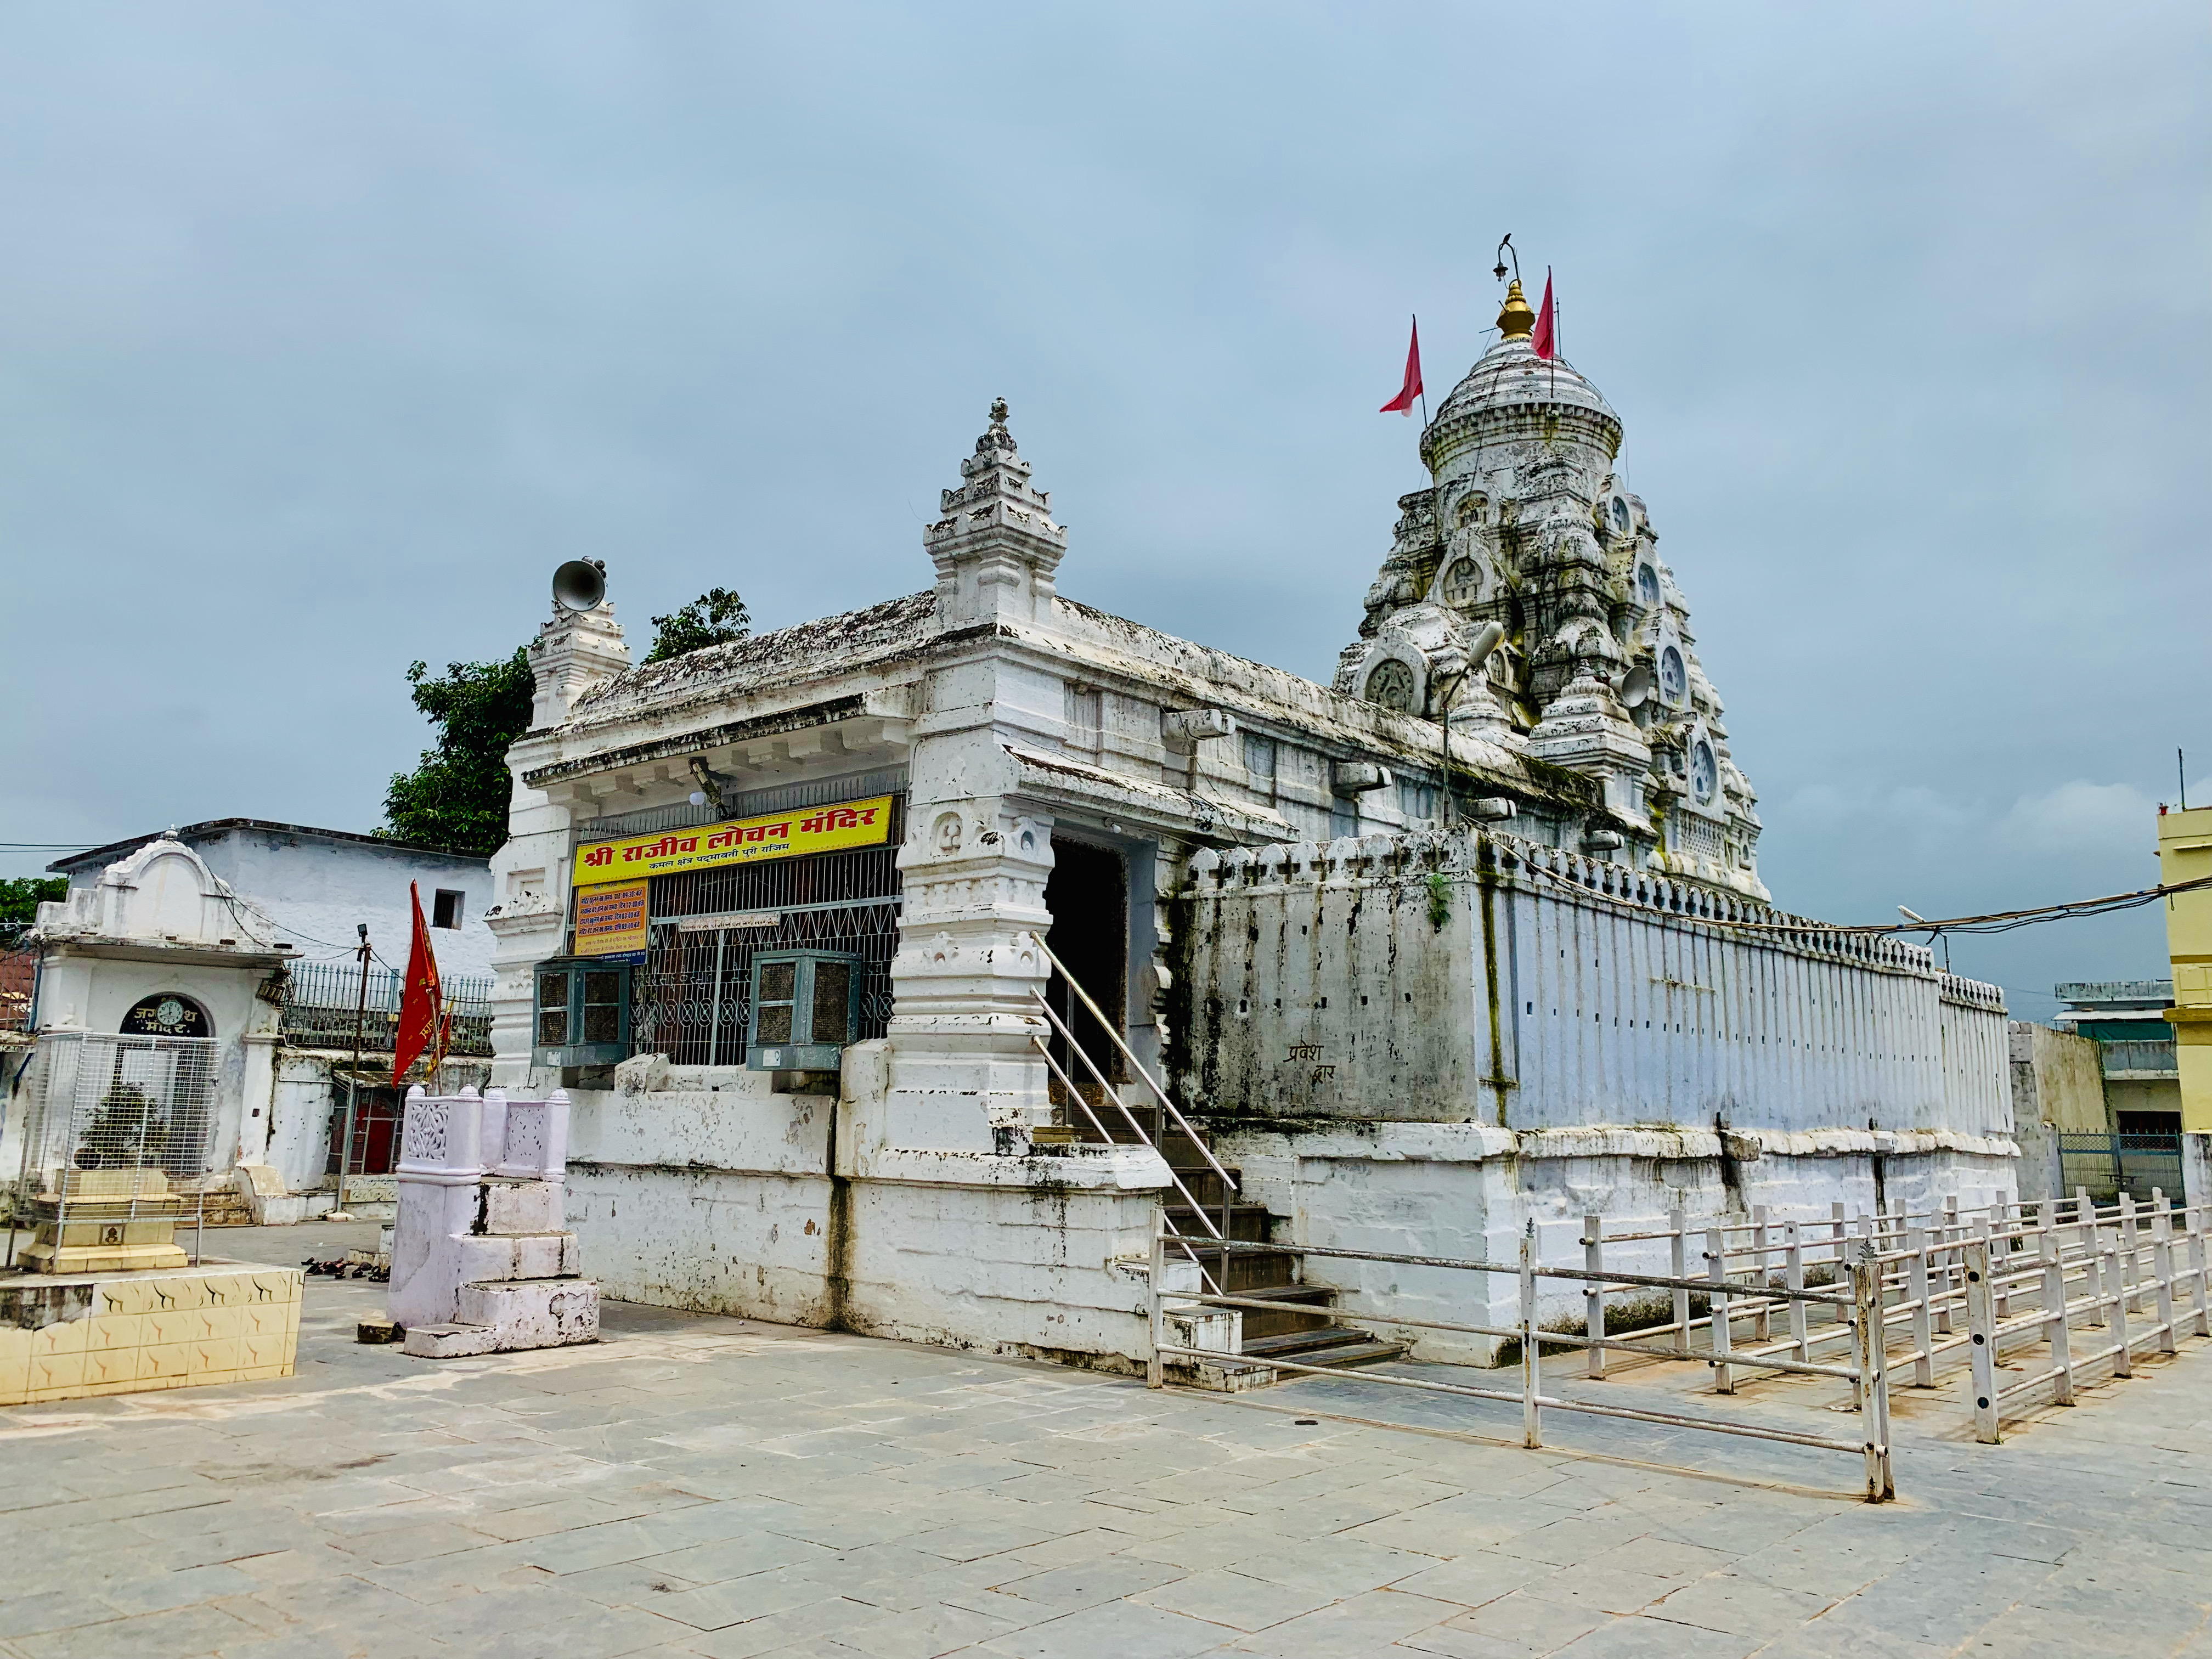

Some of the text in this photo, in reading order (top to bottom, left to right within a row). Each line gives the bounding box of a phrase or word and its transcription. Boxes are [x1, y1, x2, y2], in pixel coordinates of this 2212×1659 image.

[583, 807, 879, 867] श्री राजीव लोचन मंदिर
[648, 843, 791, 870] कमल क्षेत्र पद्मावती पुरी राजिम
[1283, 1040, 1325, 1063] प्रवेश
[1312, 1065, 1337, 1085] द्वार
